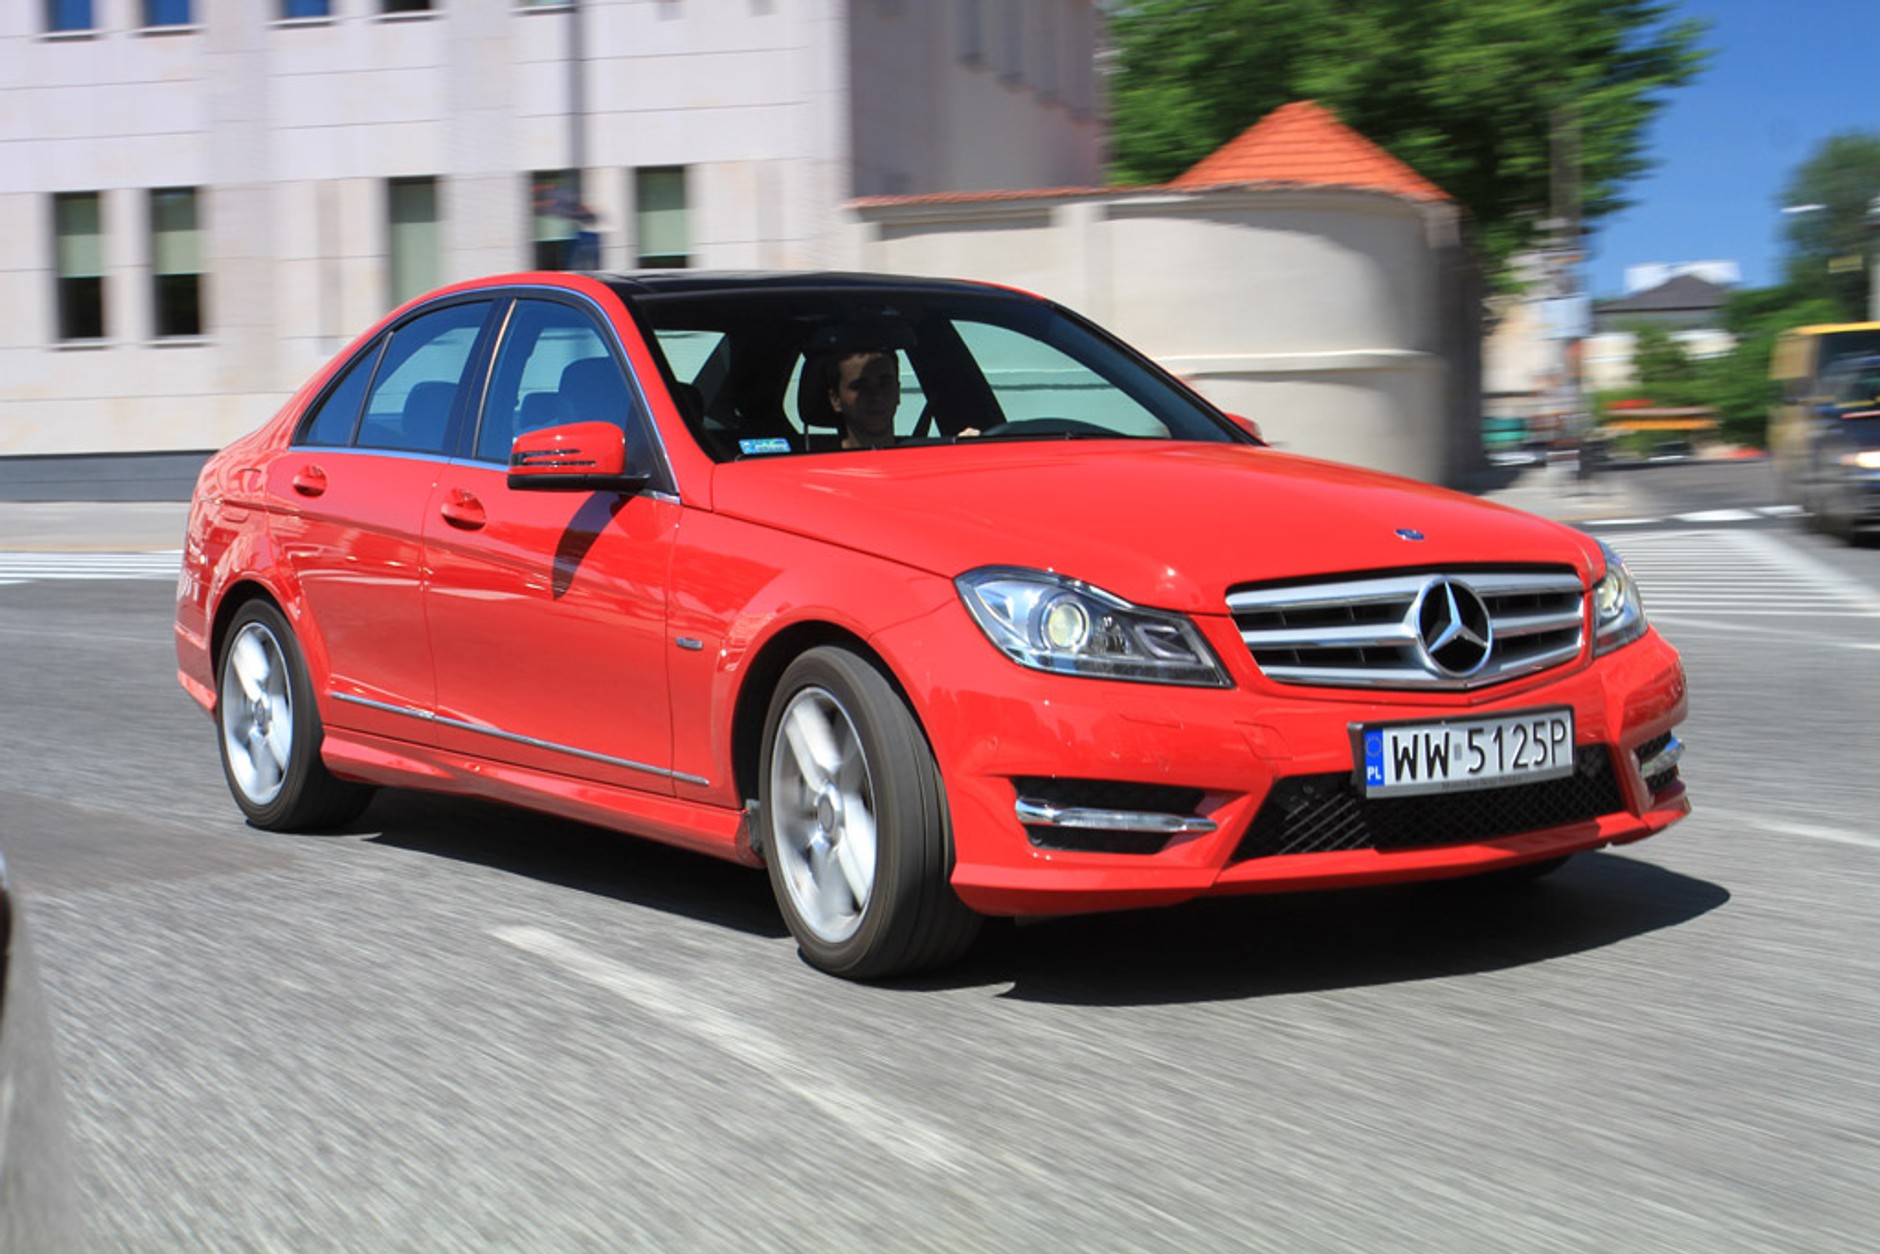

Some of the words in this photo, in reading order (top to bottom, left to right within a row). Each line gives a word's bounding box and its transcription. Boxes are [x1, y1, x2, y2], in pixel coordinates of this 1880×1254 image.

[1392, 731, 1450, 781] WW
[1467, 718, 1566, 774] 5125P
[1366, 765, 1382, 780] PL
